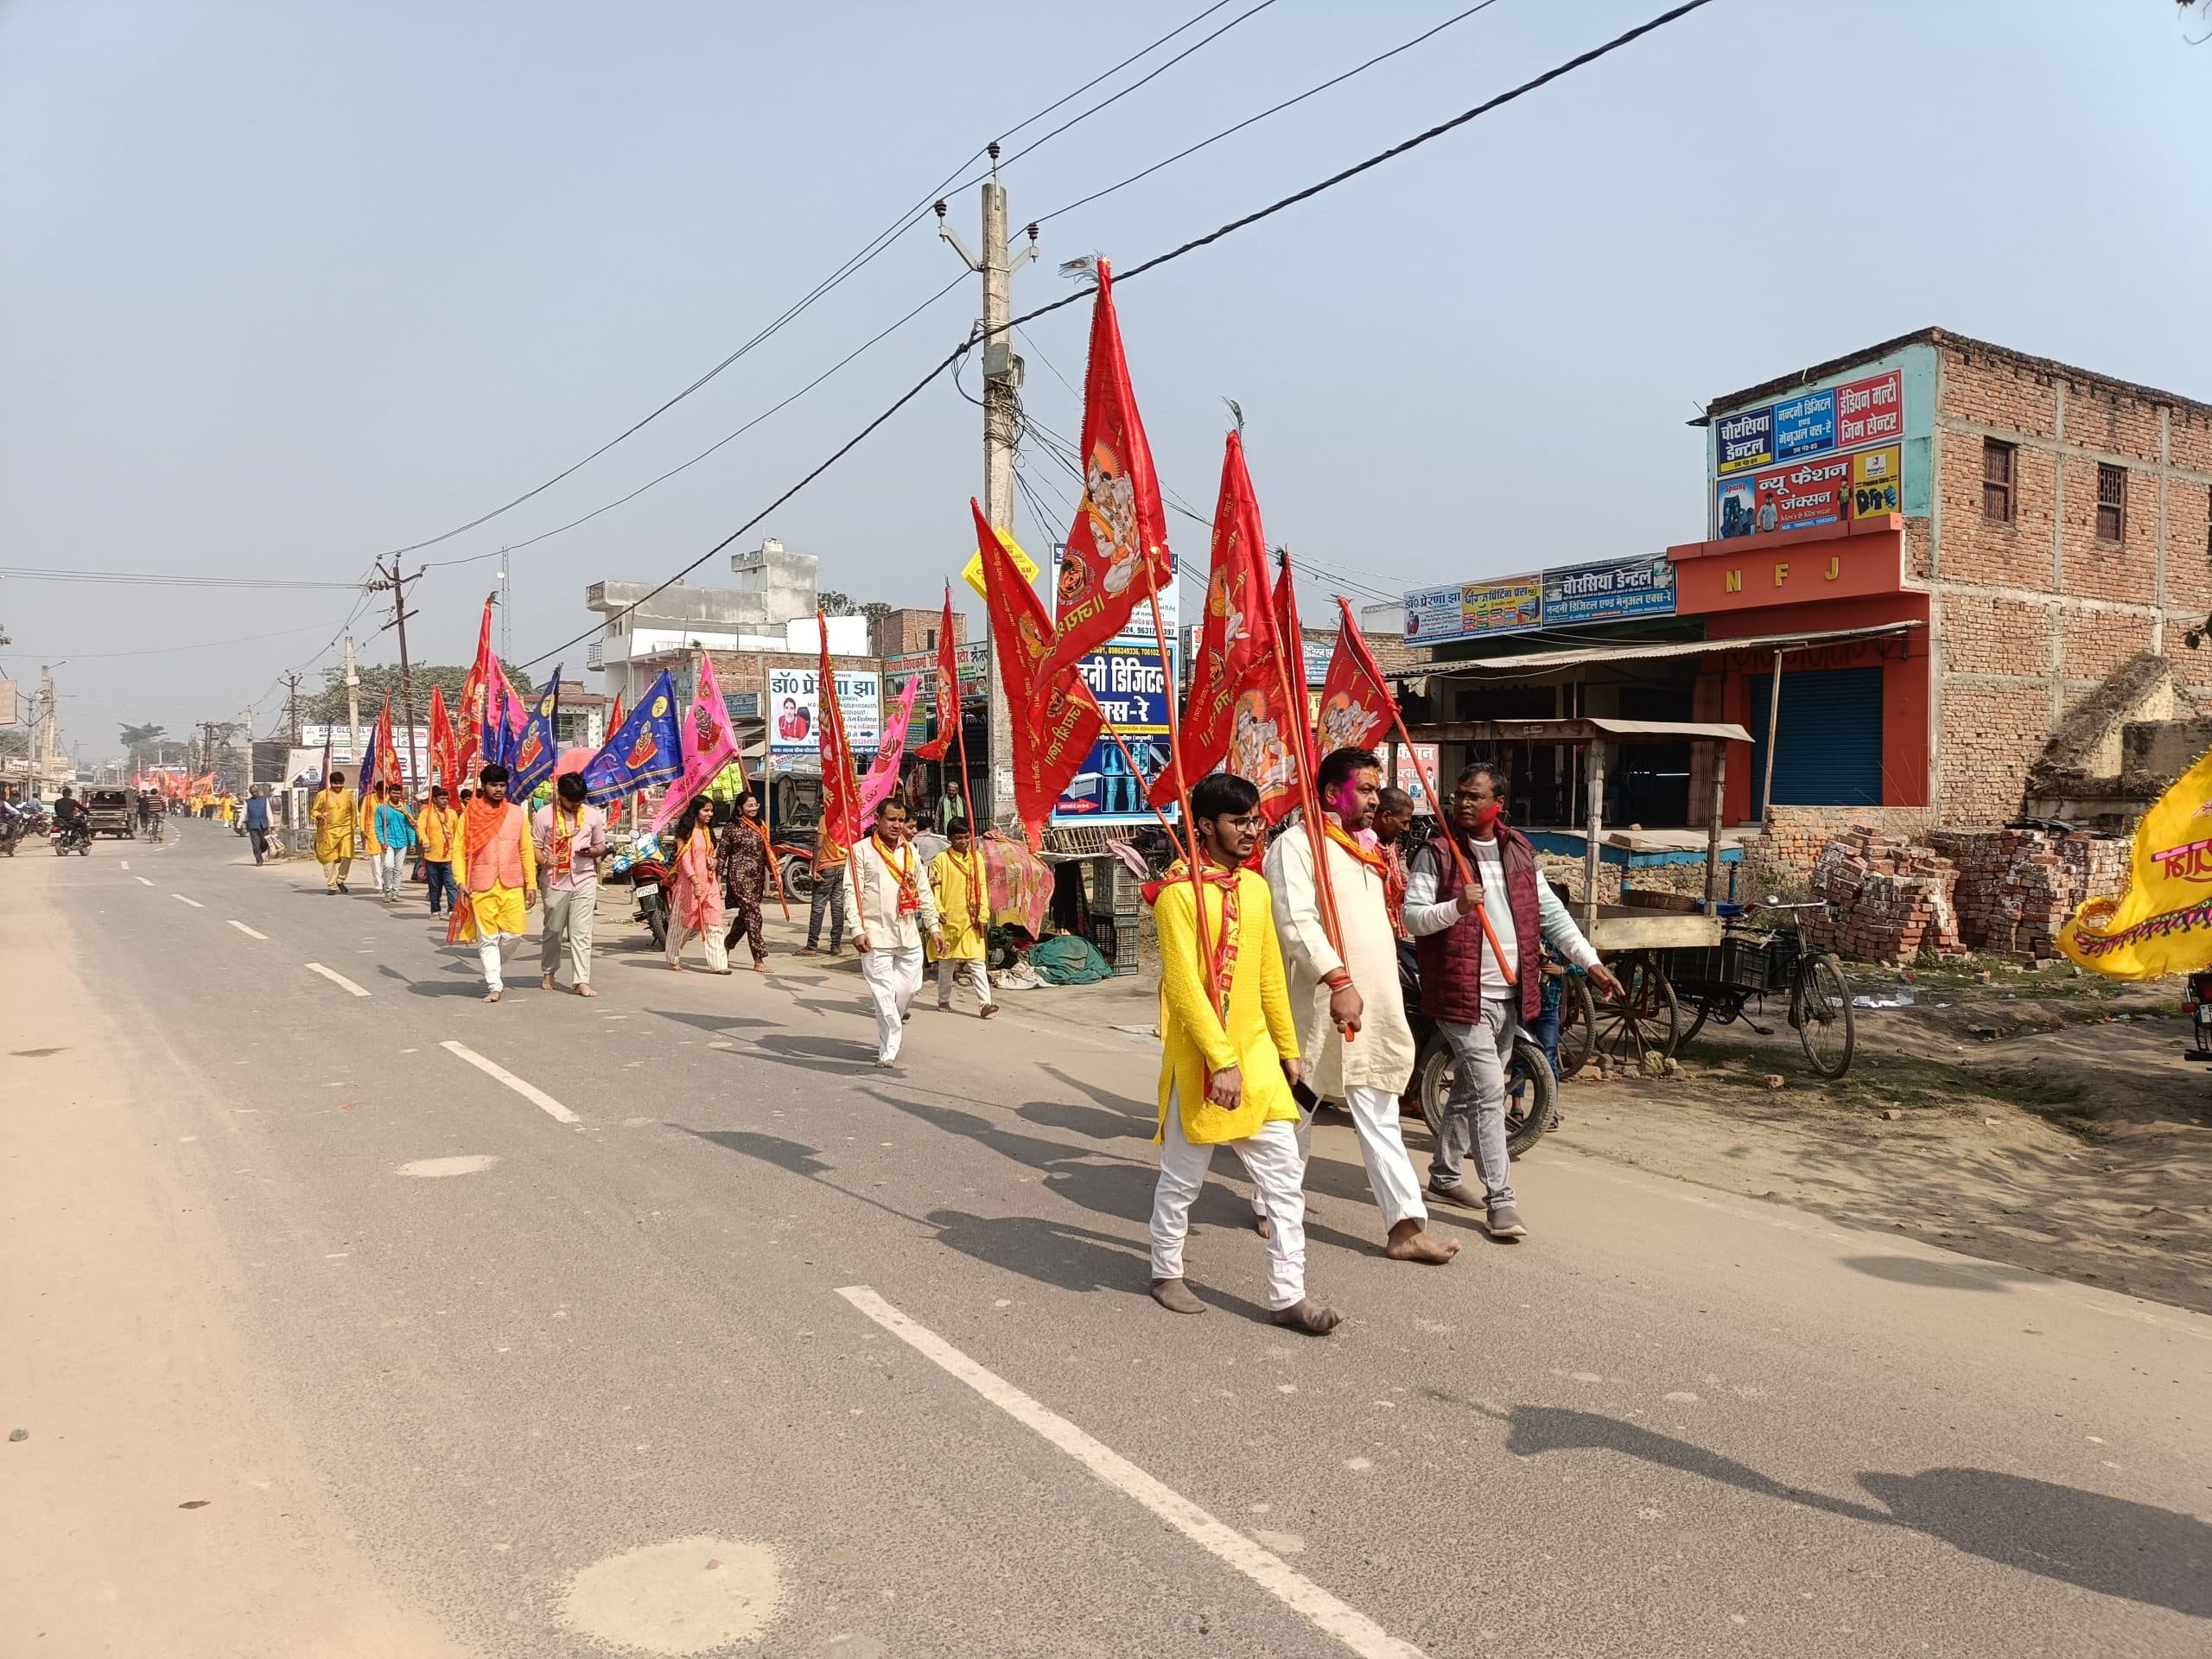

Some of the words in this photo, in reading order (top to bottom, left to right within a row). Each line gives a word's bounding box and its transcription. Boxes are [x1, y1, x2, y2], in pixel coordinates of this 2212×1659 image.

[1804, 397, 1831, 415] डिजिटल
[1840, 389, 1870, 417] इंडियन
[1872, 377, 1897, 405] मल्टी
[1841, 419, 1864, 442] जिम
[1866, 412, 1897, 435] सेन्टर
[1726, 438, 1764, 461] डेन्टल
[1758, 475, 1790, 496] न्यू
[1790, 462, 1848, 485] फैशन
[1617, 569, 1653, 588] डेन्टल
[1726, 570, 1741, 592] N
[1775, 563, 1789, 586] F
[1825, 556, 1839, 580] J
[1448, 592, 1460, 604] झा
[1569, 600, 1598, 613] डिजिटल
[853, 681, 875, 697] झा
